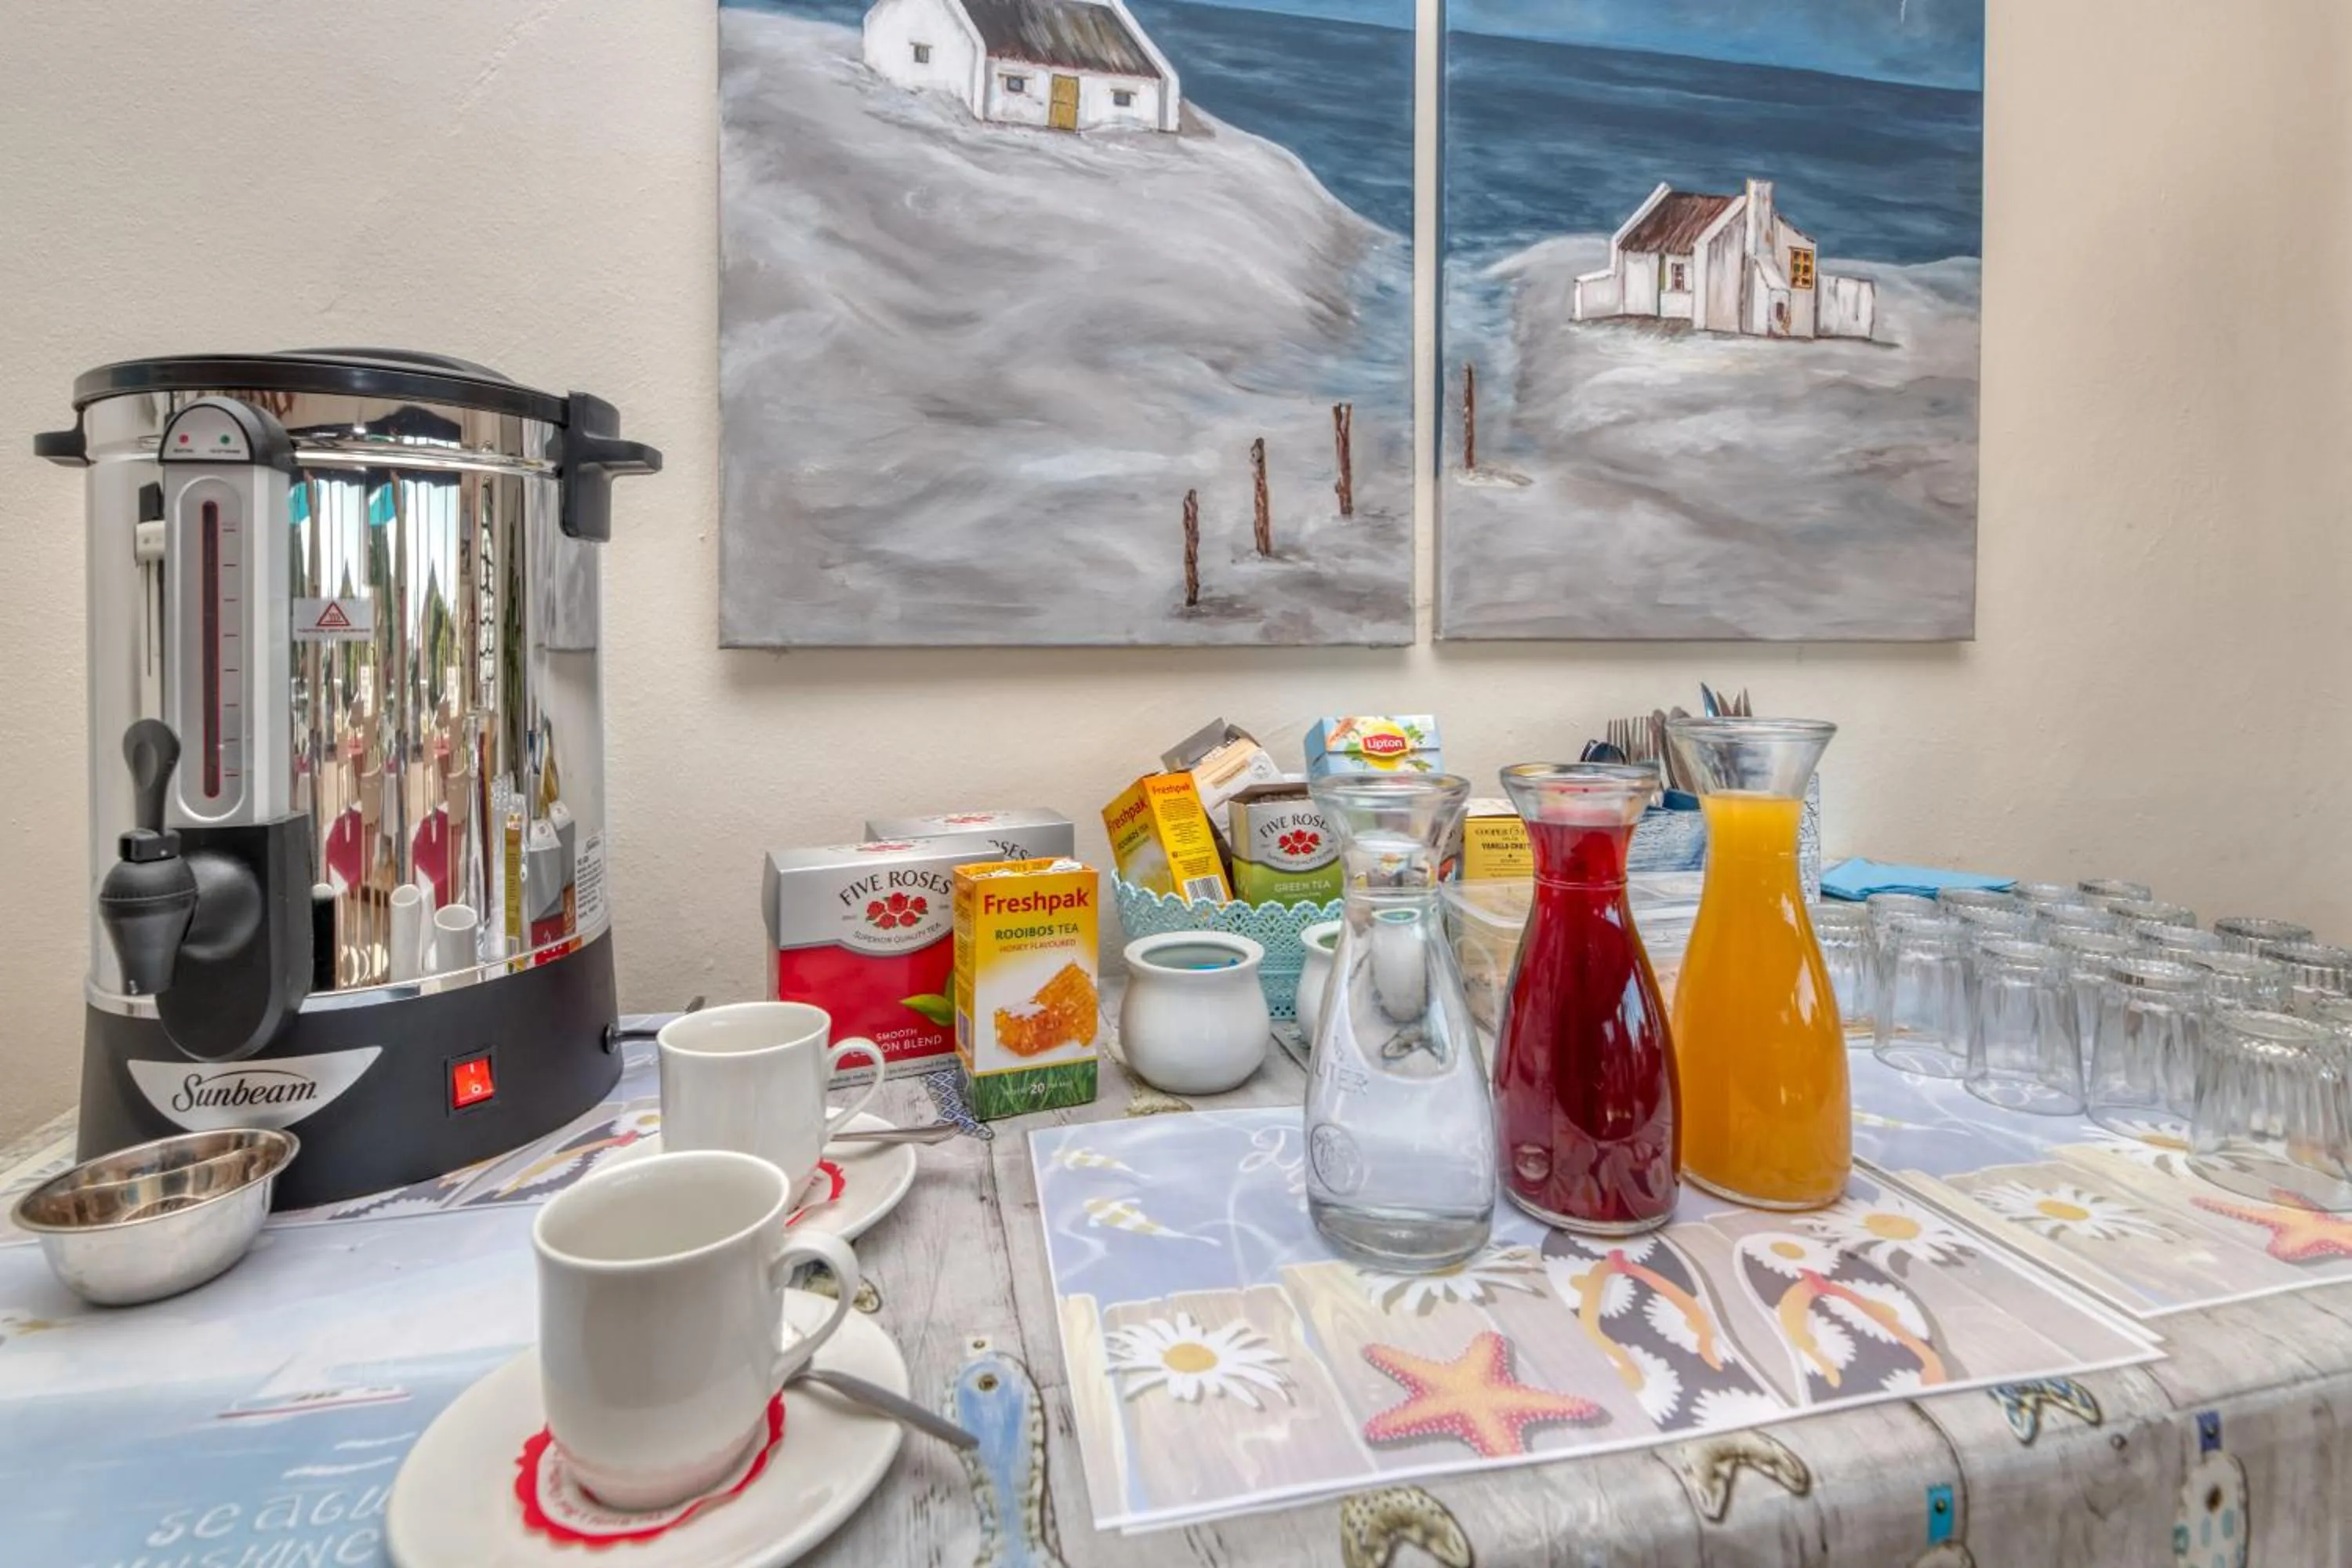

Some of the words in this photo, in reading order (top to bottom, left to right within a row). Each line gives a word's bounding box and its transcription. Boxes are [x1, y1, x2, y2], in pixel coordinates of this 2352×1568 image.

[1367, 739, 1403, 750] Lipton
[1152, 783, 1191, 796] Freshpak
[1108, 796, 1149, 835] Freshpak
[1260, 816, 1289, 838] FIVE
[988, 839, 1029, 861] SES
[839, 873, 884, 906] FIVE
[888, 869, 953, 895] ROSES
[1274, 882, 1310, 893] GREEN
[1312, 880, 1331, 889] TEA
[984, 887, 1090, 916] Freshpak
[995, 924, 1054, 940] ROOIBOS
[1058, 923, 1079, 935] TEA
[1000, 943, 1029, 953] HONEY
[876, 1028, 917, 1041] SMOOTH
[903, 1034, 942, 1050] BLEND
[172, 1070, 317, 1112] Sunbeam
[1030, 1082, 1045, 1094] 20
